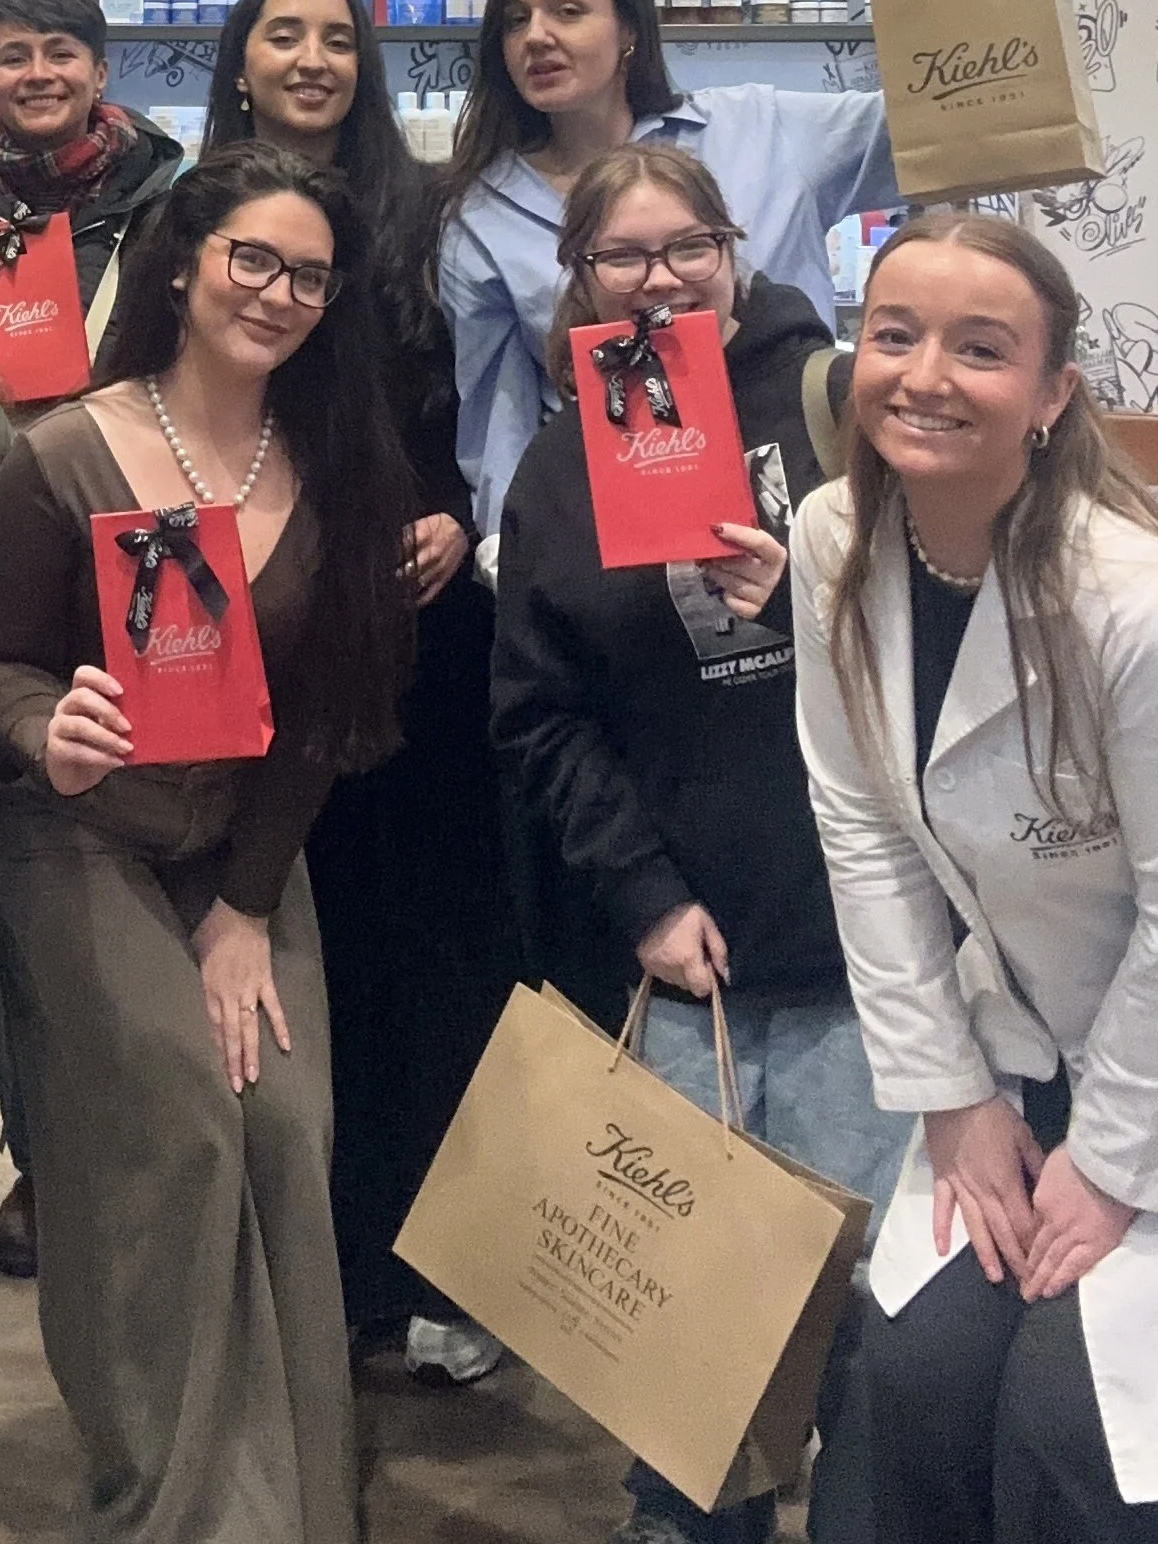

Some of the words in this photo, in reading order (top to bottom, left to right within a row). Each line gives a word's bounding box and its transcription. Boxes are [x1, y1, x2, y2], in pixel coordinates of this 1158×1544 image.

[907, 37, 1039, 93] Kiehl's
[940, 98, 984, 111] SINCE
[617, 427, 706, 462] Kiehl's
[701, 660, 737, 680] LIZZY
[586, 1123, 695, 1217] Kiehl's
[533, 1197, 673, 1309] APOTHECARY
[588, 1204, 641, 1253] FINE
[537, 1228, 646, 1321] SKINCARE
